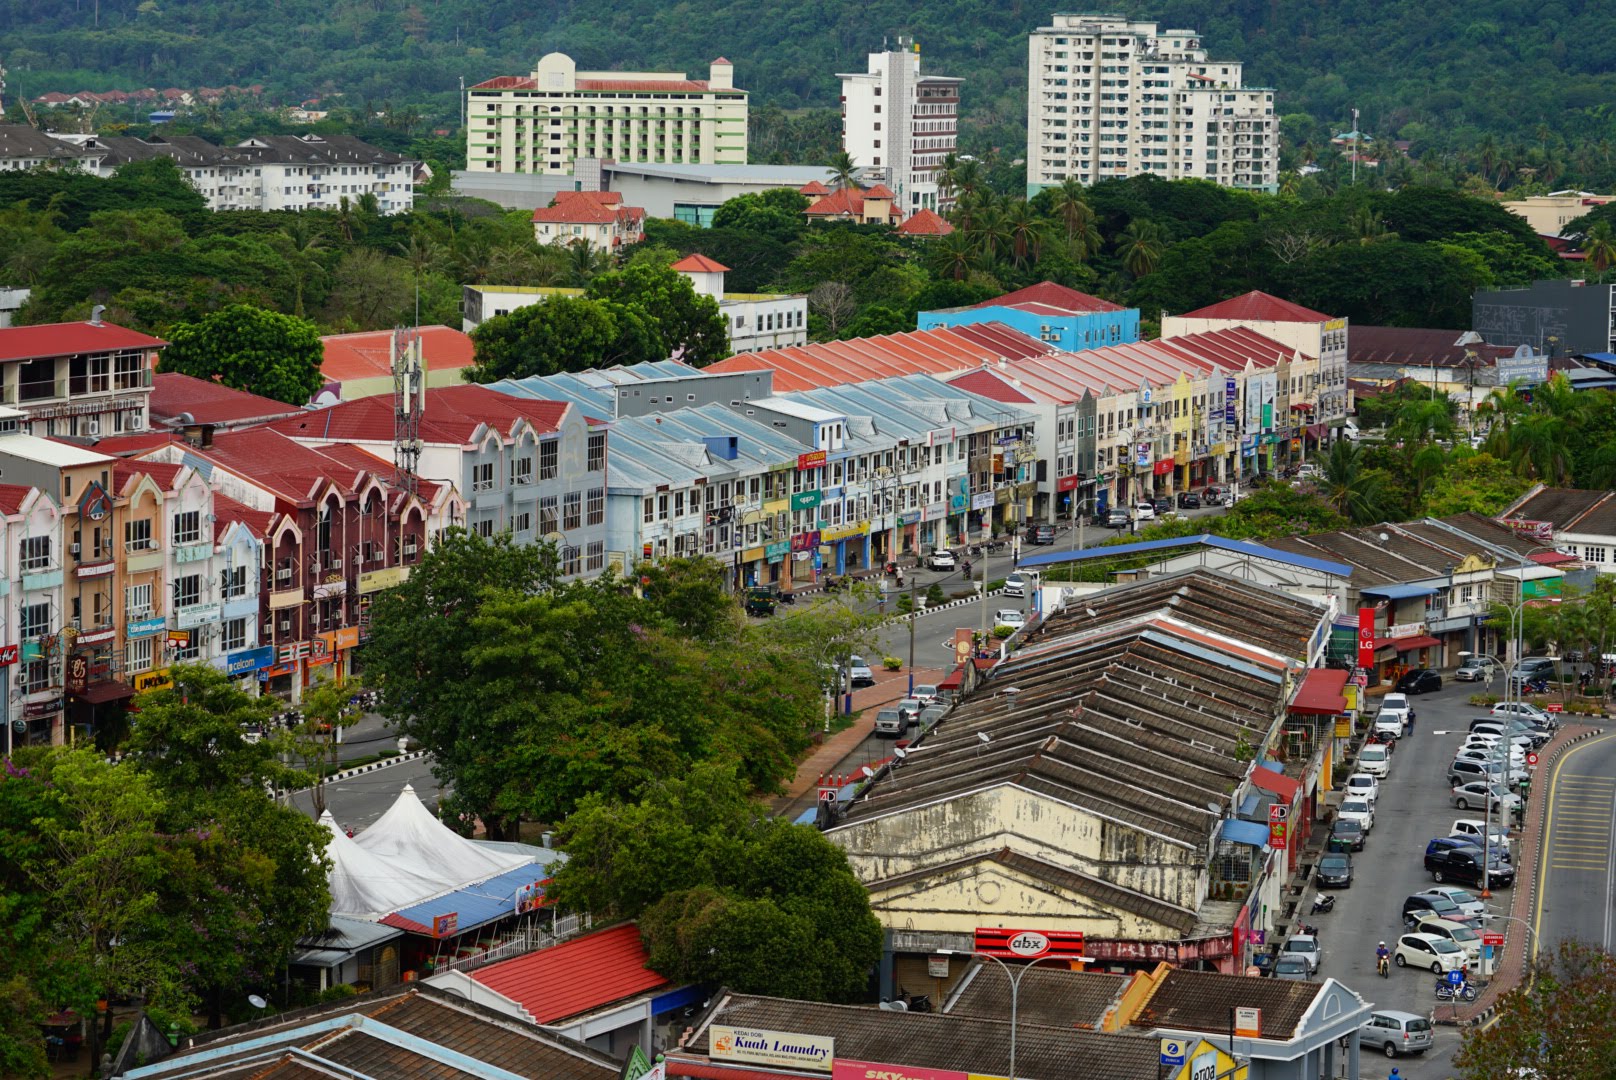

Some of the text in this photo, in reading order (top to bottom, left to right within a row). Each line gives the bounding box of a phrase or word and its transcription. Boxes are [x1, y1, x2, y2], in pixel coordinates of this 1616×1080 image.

[1359, 641, 1373, 649] LG
[233, 658, 255, 671] celcom
[1271, 806, 1287, 818] 4D
[1012, 936, 1041, 949] abx
[735, 1036, 830, 1060] Kuah Laundry
